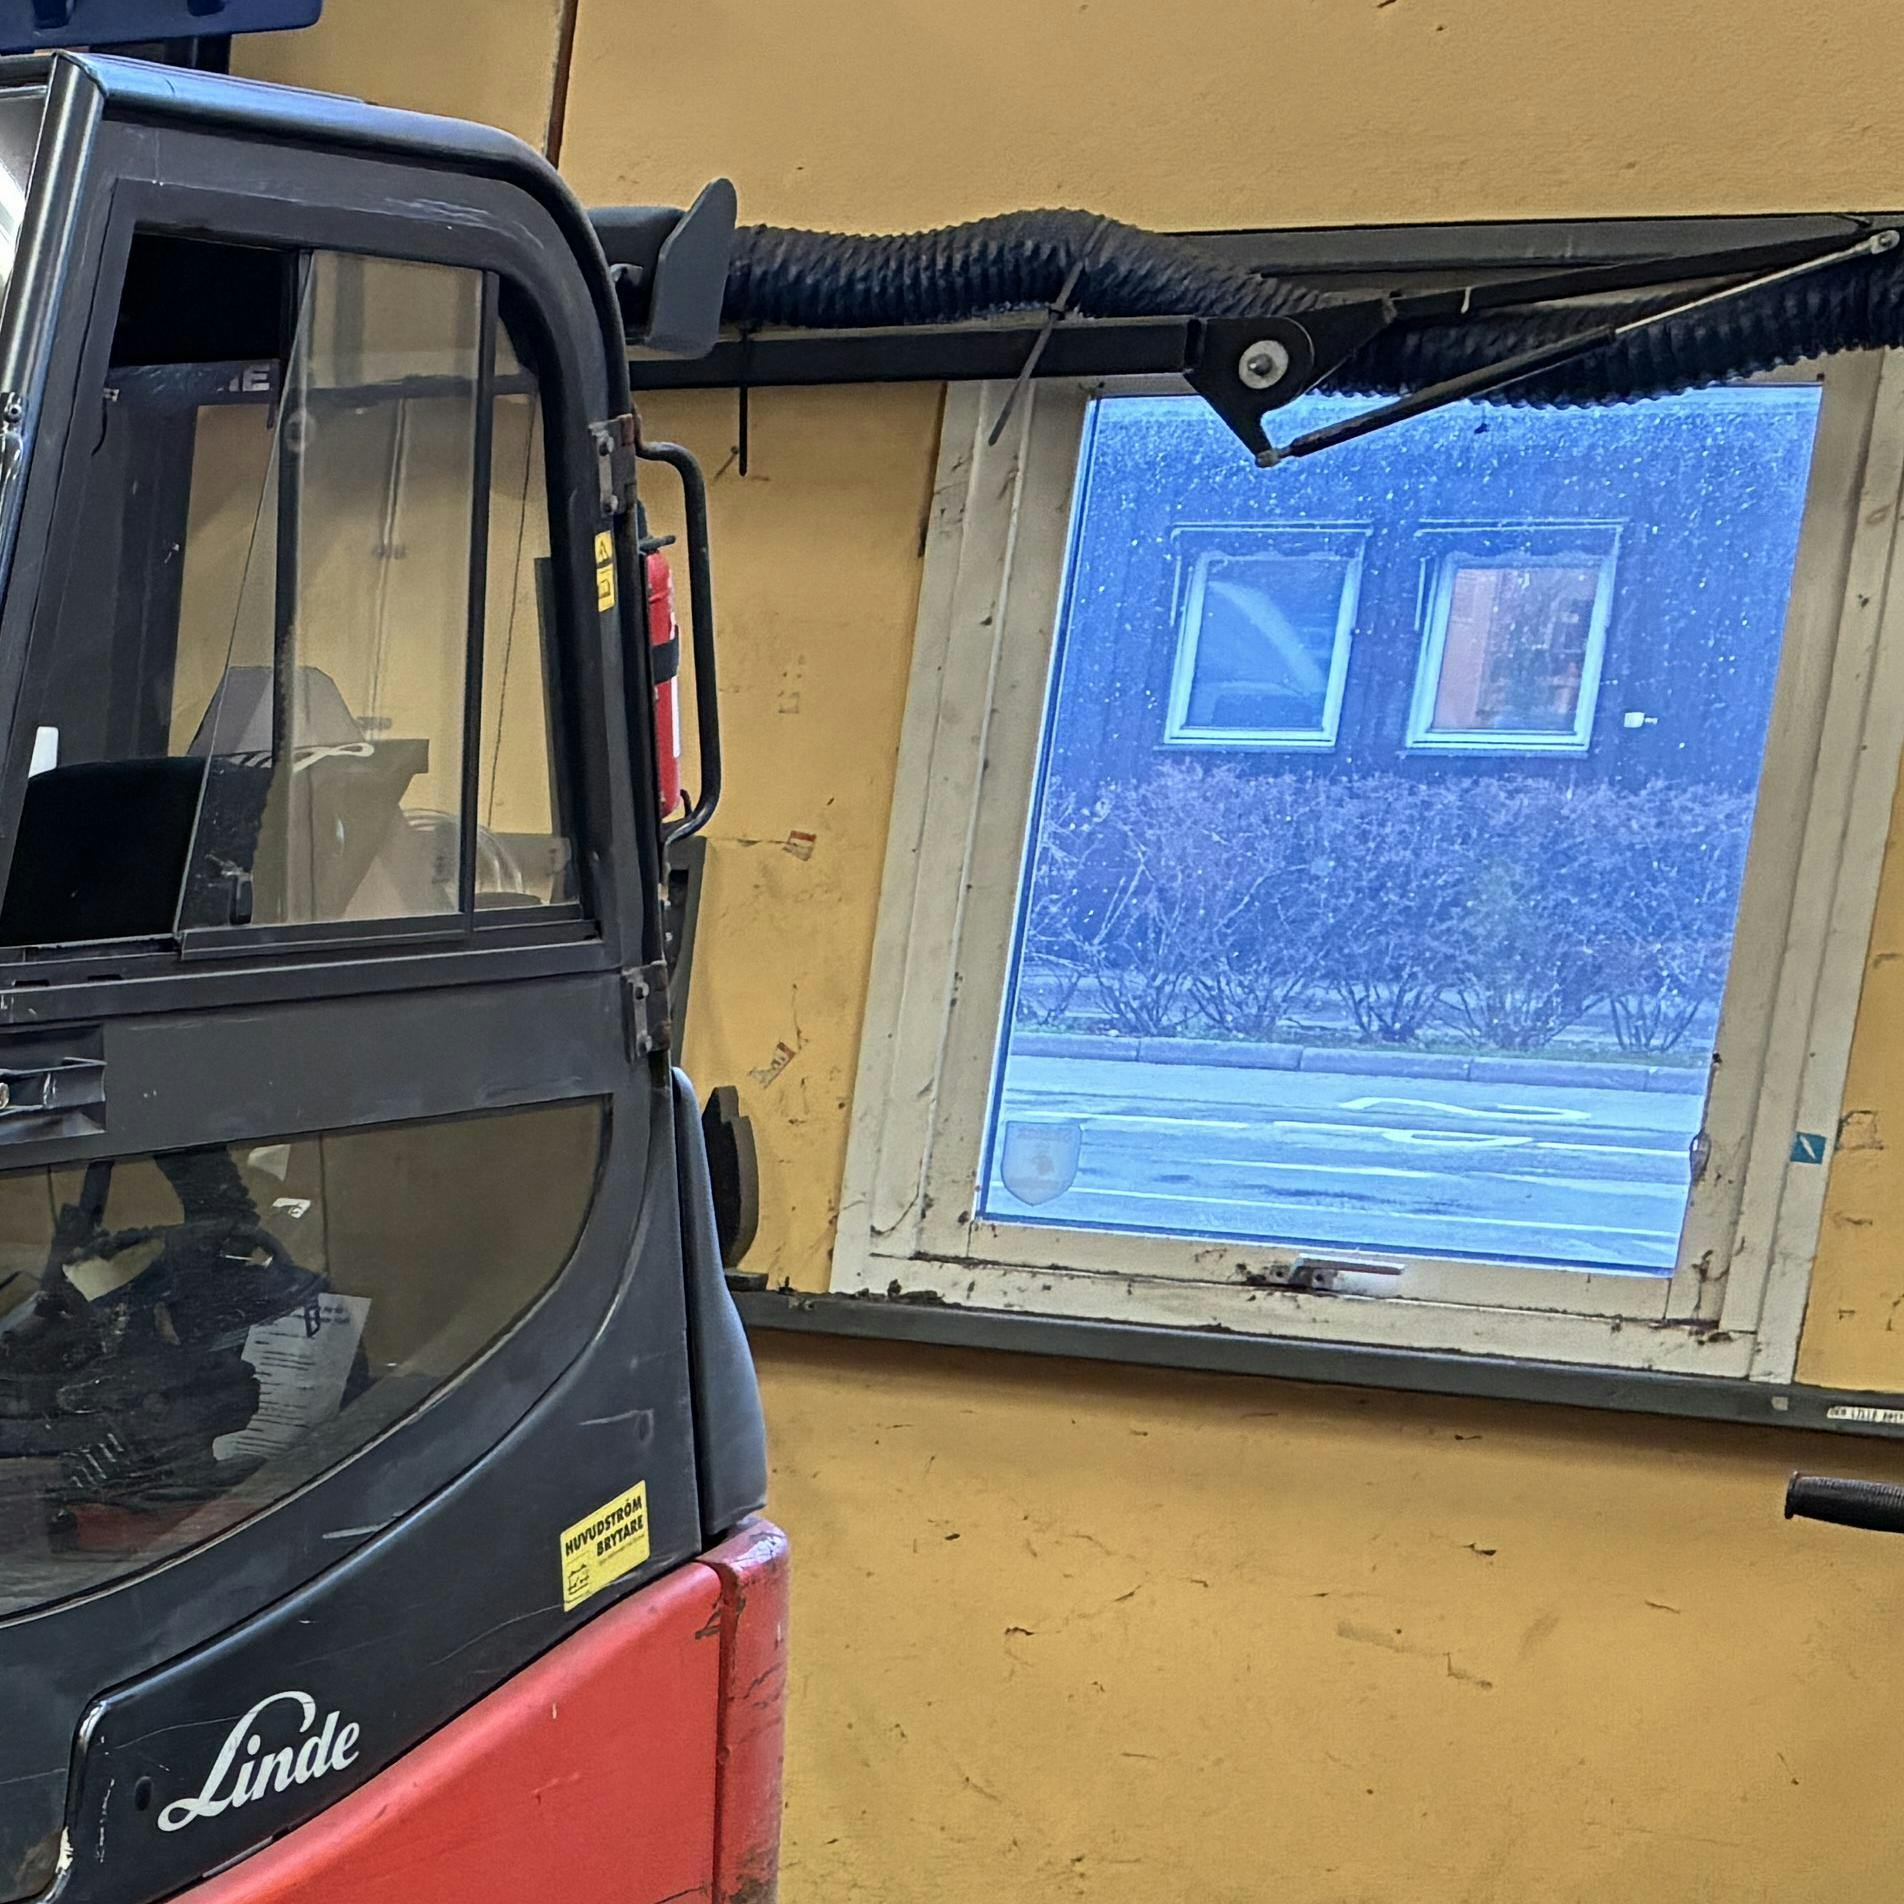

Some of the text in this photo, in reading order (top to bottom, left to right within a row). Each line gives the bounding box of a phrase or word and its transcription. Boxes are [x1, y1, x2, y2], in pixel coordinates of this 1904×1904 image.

[565, 1495, 643, 1557] HUVUDSTRÖM
[596, 1514, 644, 1557] BRYTARE
[157, 1690, 361, 1831] Linde
